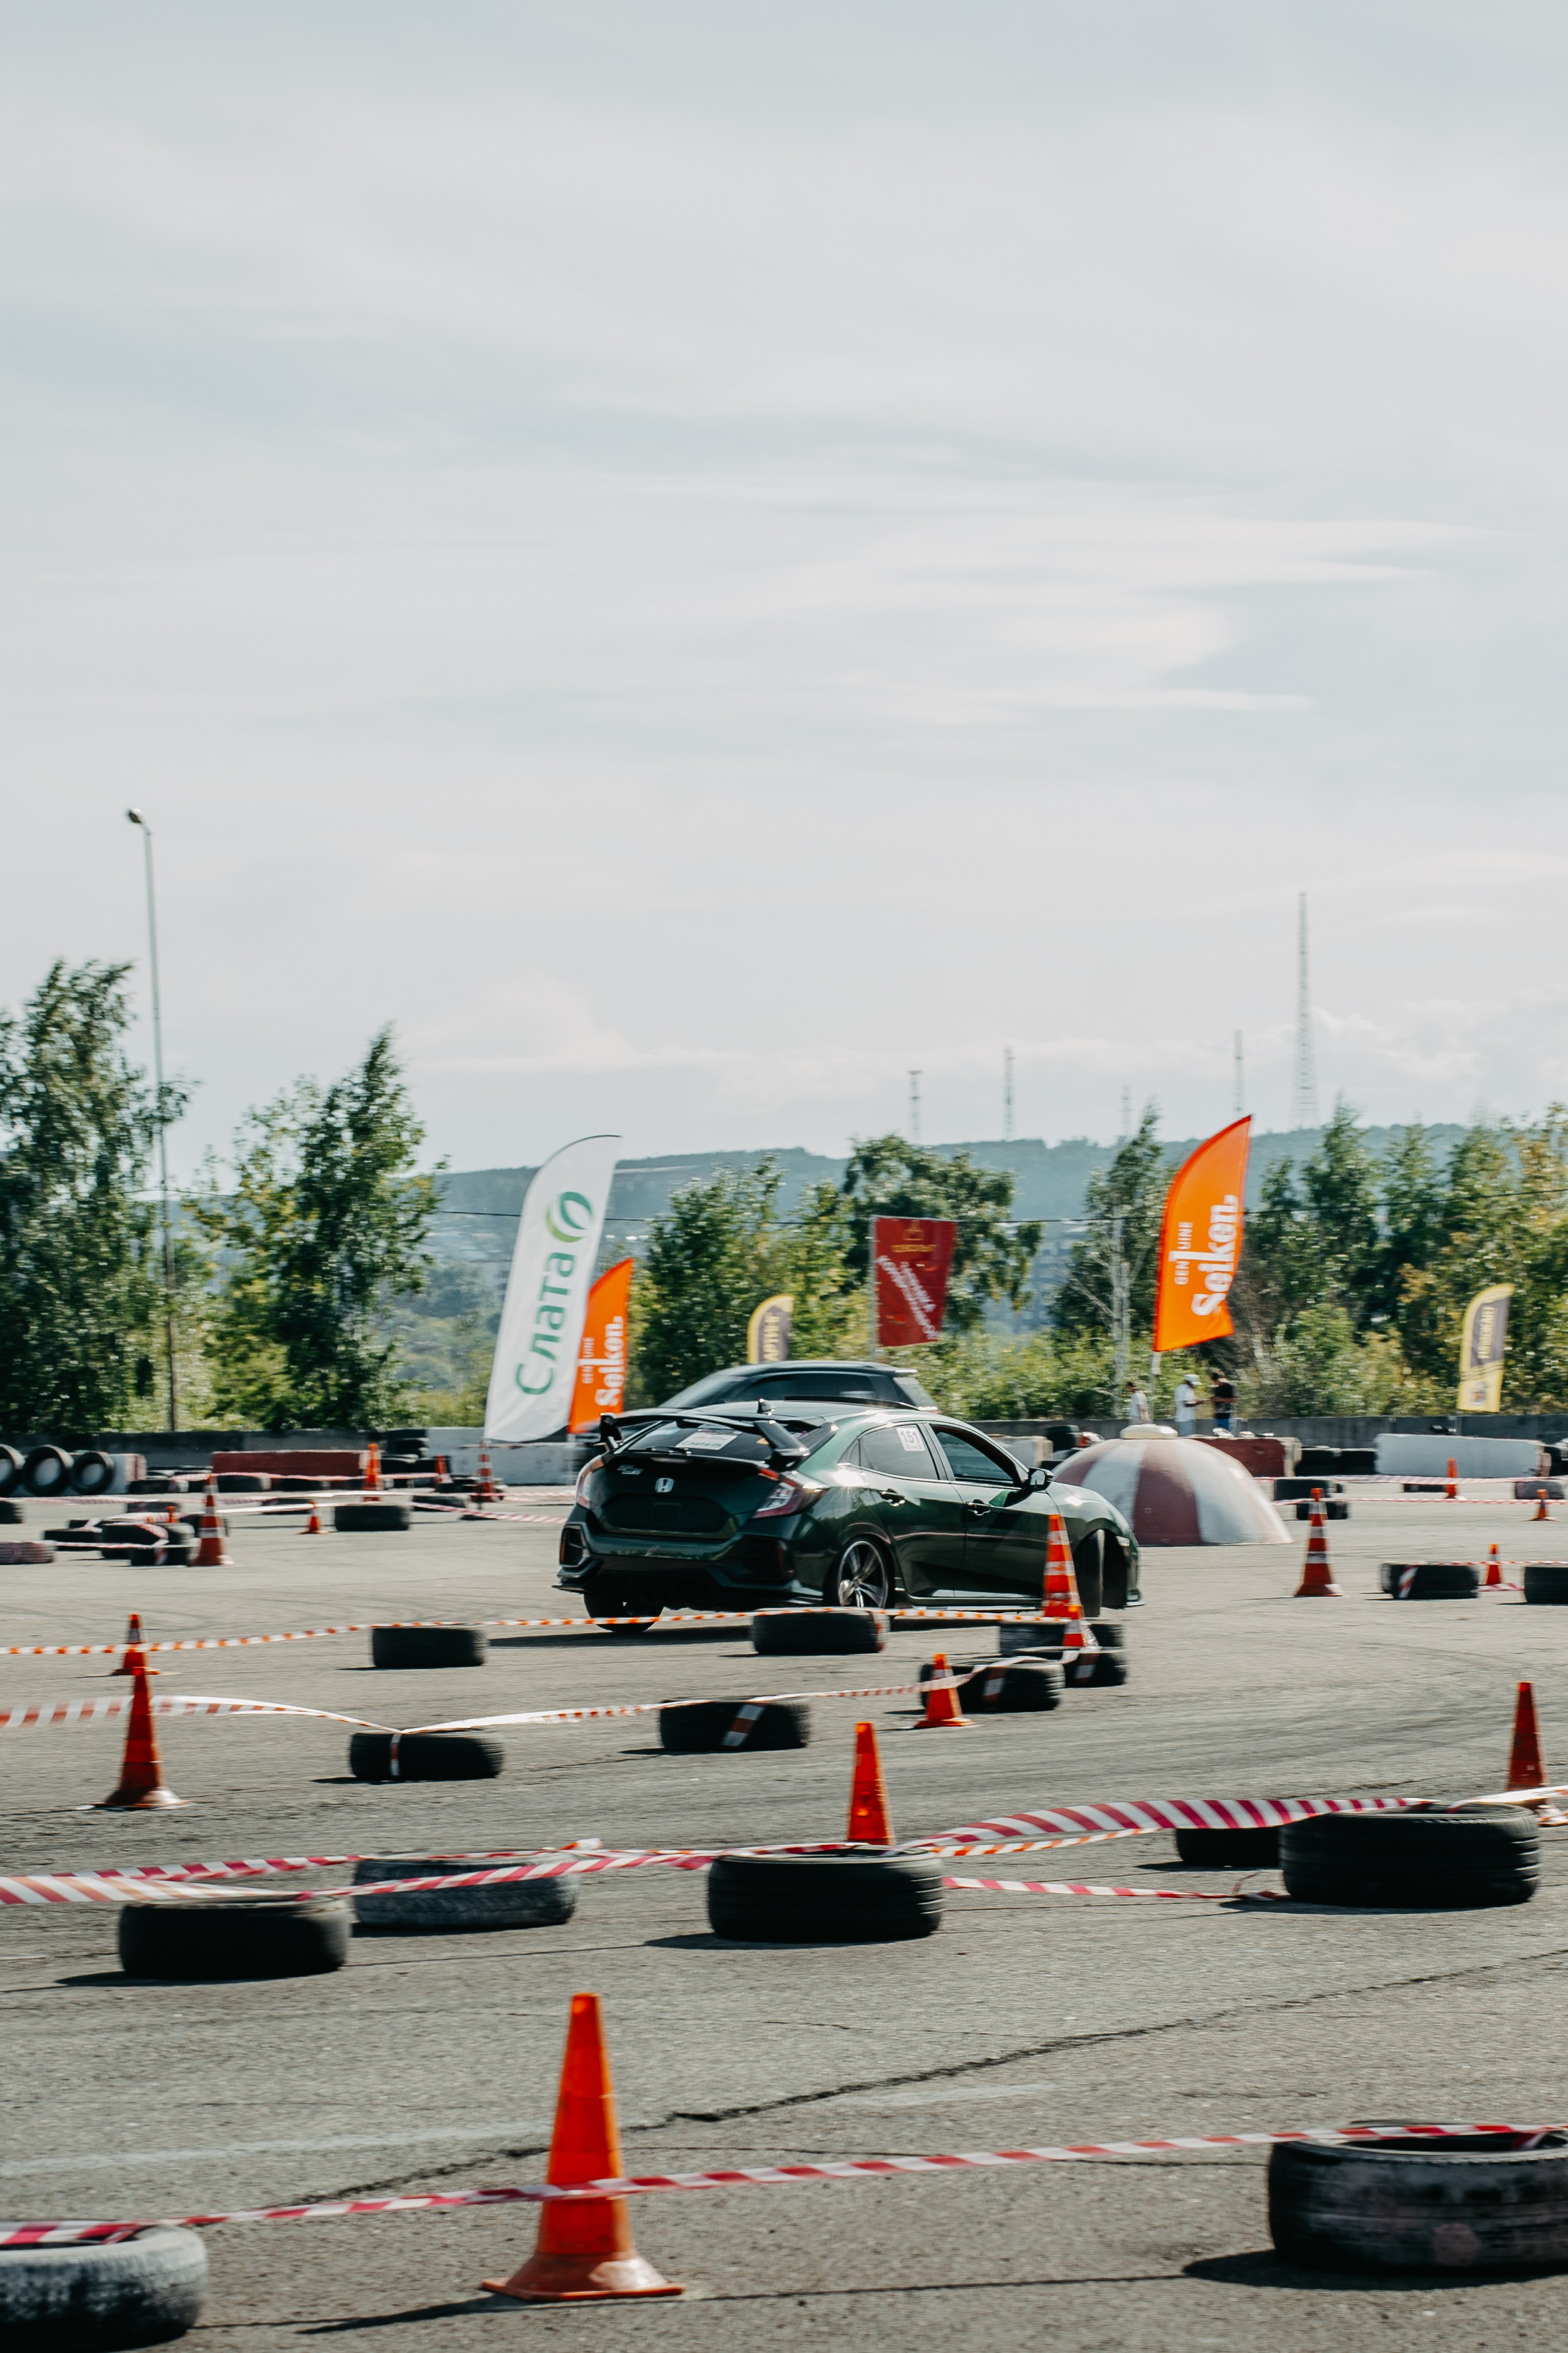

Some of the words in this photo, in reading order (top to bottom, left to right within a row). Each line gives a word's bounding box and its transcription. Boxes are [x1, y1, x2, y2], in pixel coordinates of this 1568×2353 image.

[1169, 1194, 1239, 1316] Seiken
[515, 1252, 576, 1396] Слата
[900, 1430, 920, 1443] 151
